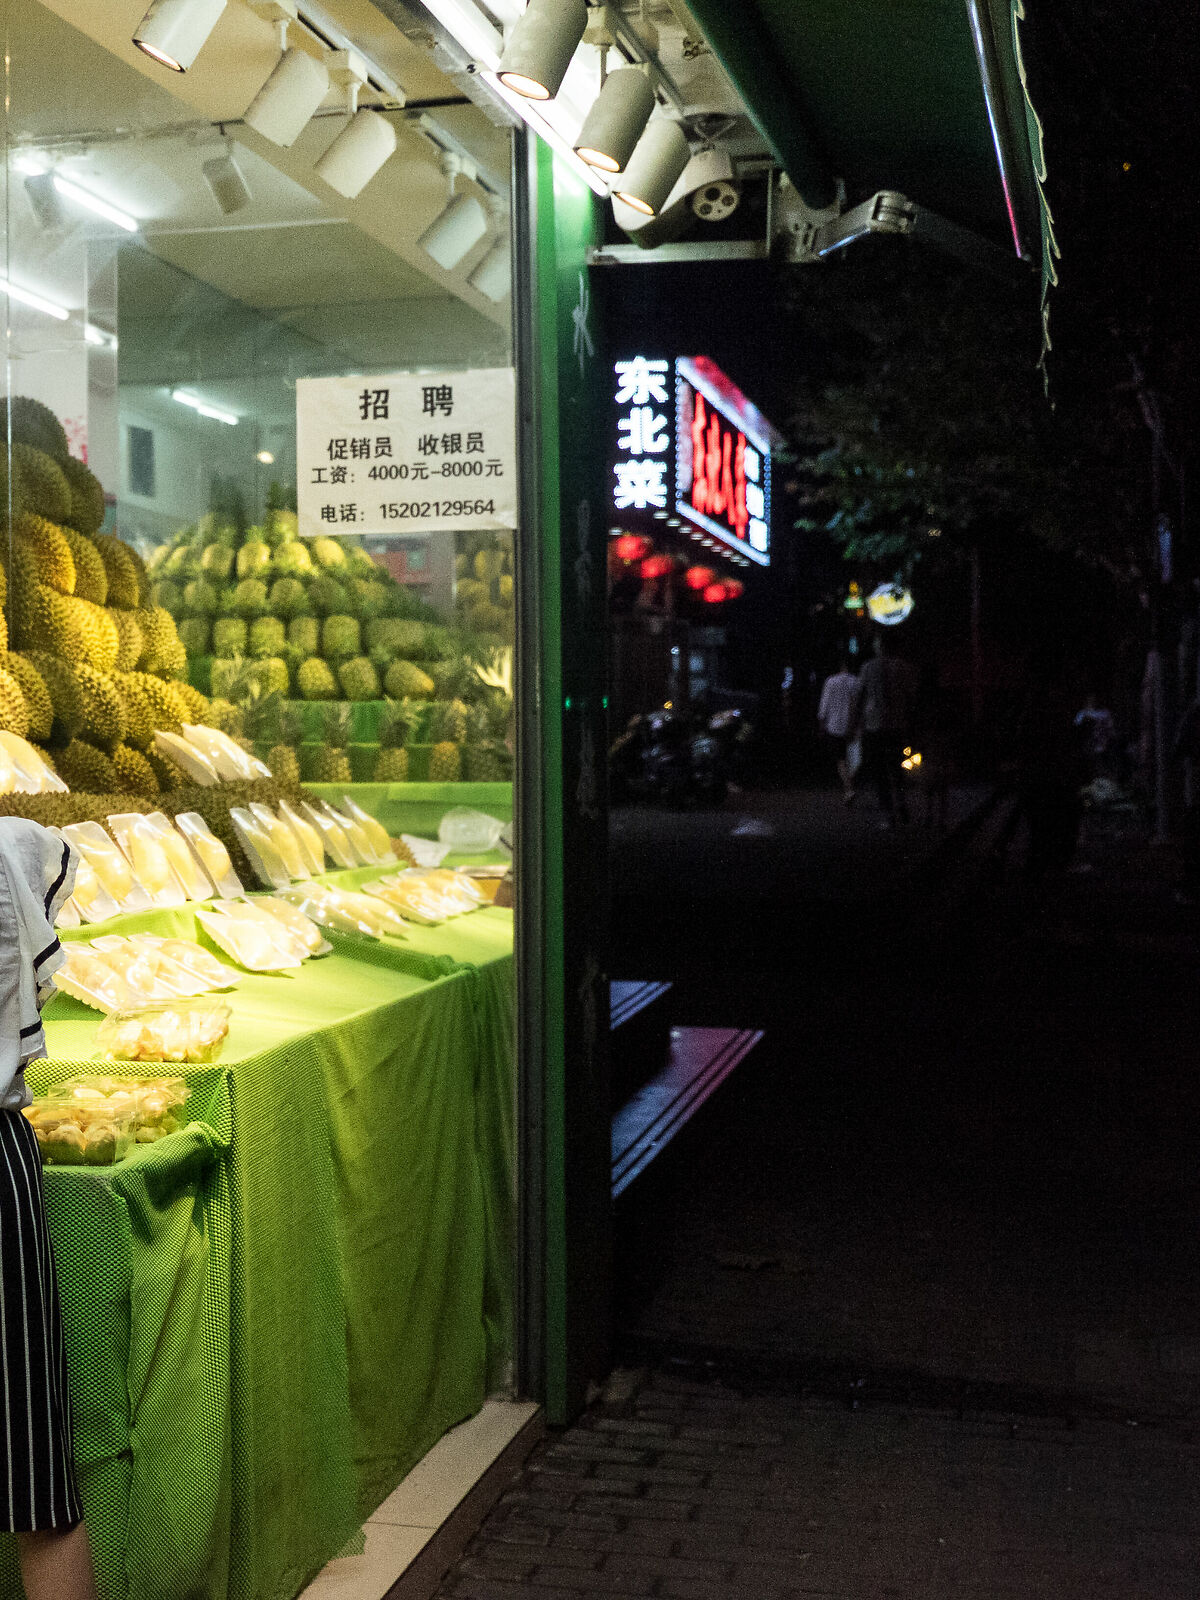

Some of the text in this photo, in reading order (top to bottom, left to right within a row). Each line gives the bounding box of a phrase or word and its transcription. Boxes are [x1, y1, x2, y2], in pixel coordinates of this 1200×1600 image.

[359, 384, 454, 420] 招聘
[327, 432, 485, 461] 促销员 收银员
[614, 356, 669, 509] 东北菜
